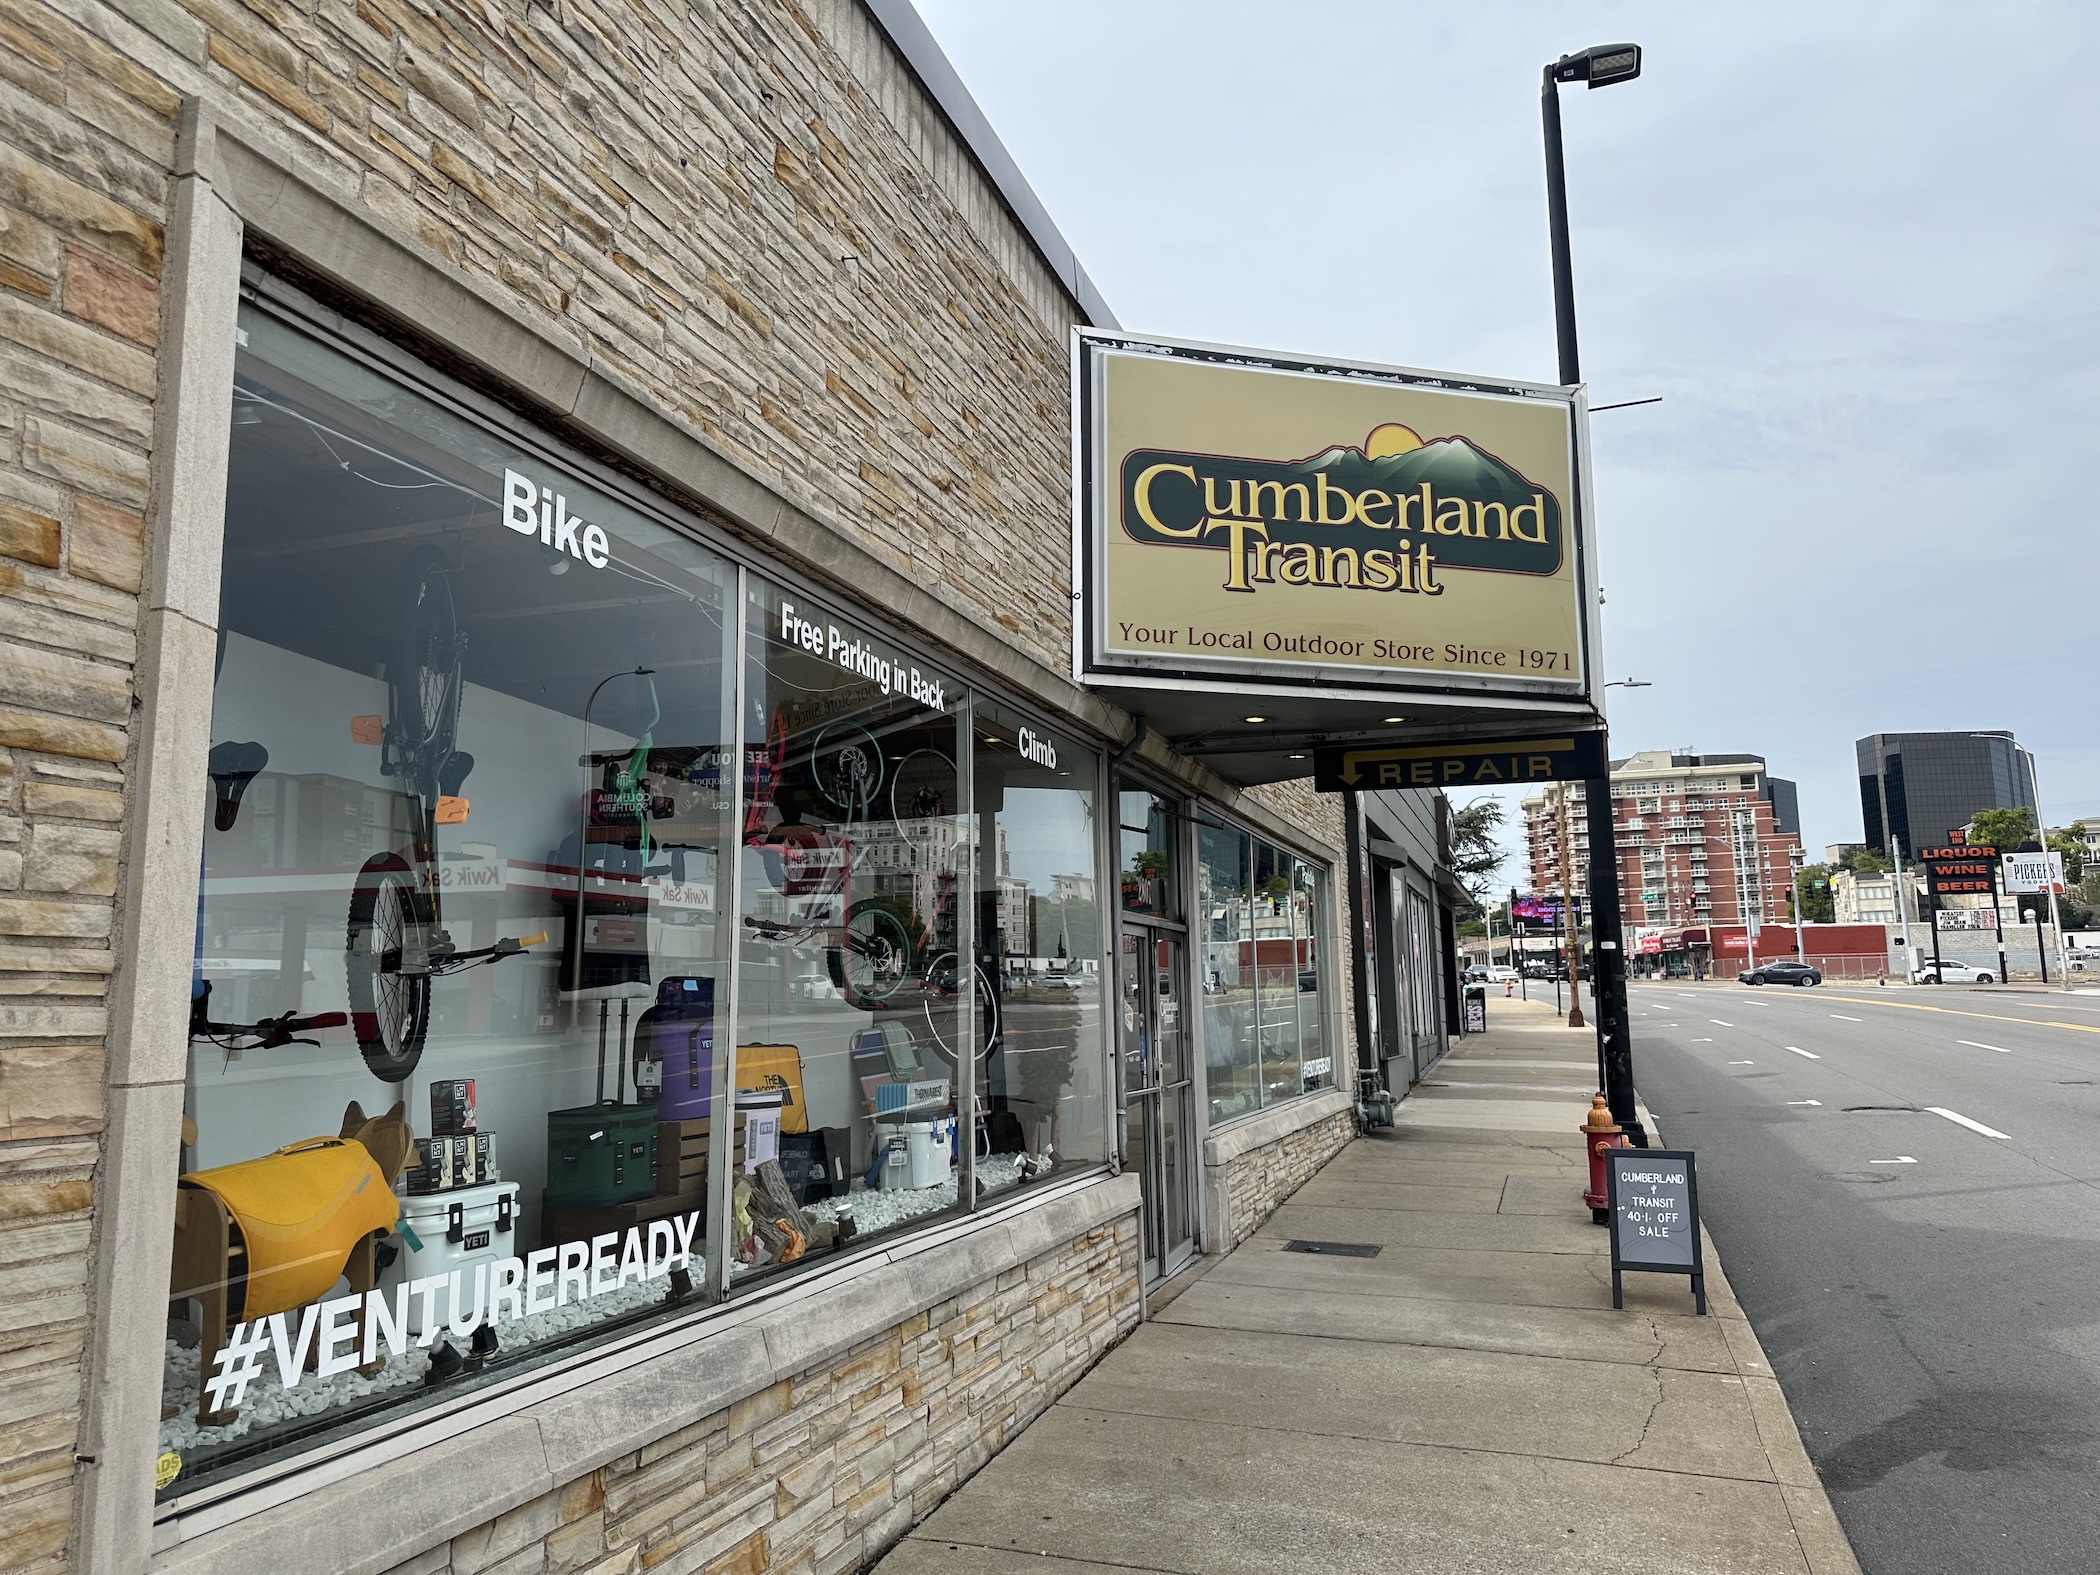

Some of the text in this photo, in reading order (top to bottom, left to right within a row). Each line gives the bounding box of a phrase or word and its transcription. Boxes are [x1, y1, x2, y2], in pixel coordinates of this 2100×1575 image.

[1133, 463, 1550, 545] Cumberland
[502, 468, 609, 568] Bike
[1203, 518, 1443, 595] Transit
[1119, 622, 1571, 671] Your Local Outdoor Store Since 1971
[781, 602, 945, 712] Free Parking in Back
[1018, 726, 1057, 770] Climb
[1379, 756, 1553, 785] REPAIR
[1922, 847, 1996, 858] LIQUOR
[1935, 864, 1988, 875] WINE
[1936, 881, 1990, 891] BEER
[701, 1040, 712, 1048] YET
[764, 1075, 779, 1085] THE
[760, 1123, 772, 1132] YETI
[632, 1146, 644, 1154] YETI
[1621, 1172, 1684, 1184] CUMBERLAND
[1632, 1197, 1675, 1208] TRANSIT
[1657, 1213, 1679, 1223] OFF
[1639, 1226, 1669, 1237] SALE
[465, 1234, 488, 1248] YETI
[204, 1211, 700, 1414] #VENTUREREADY
